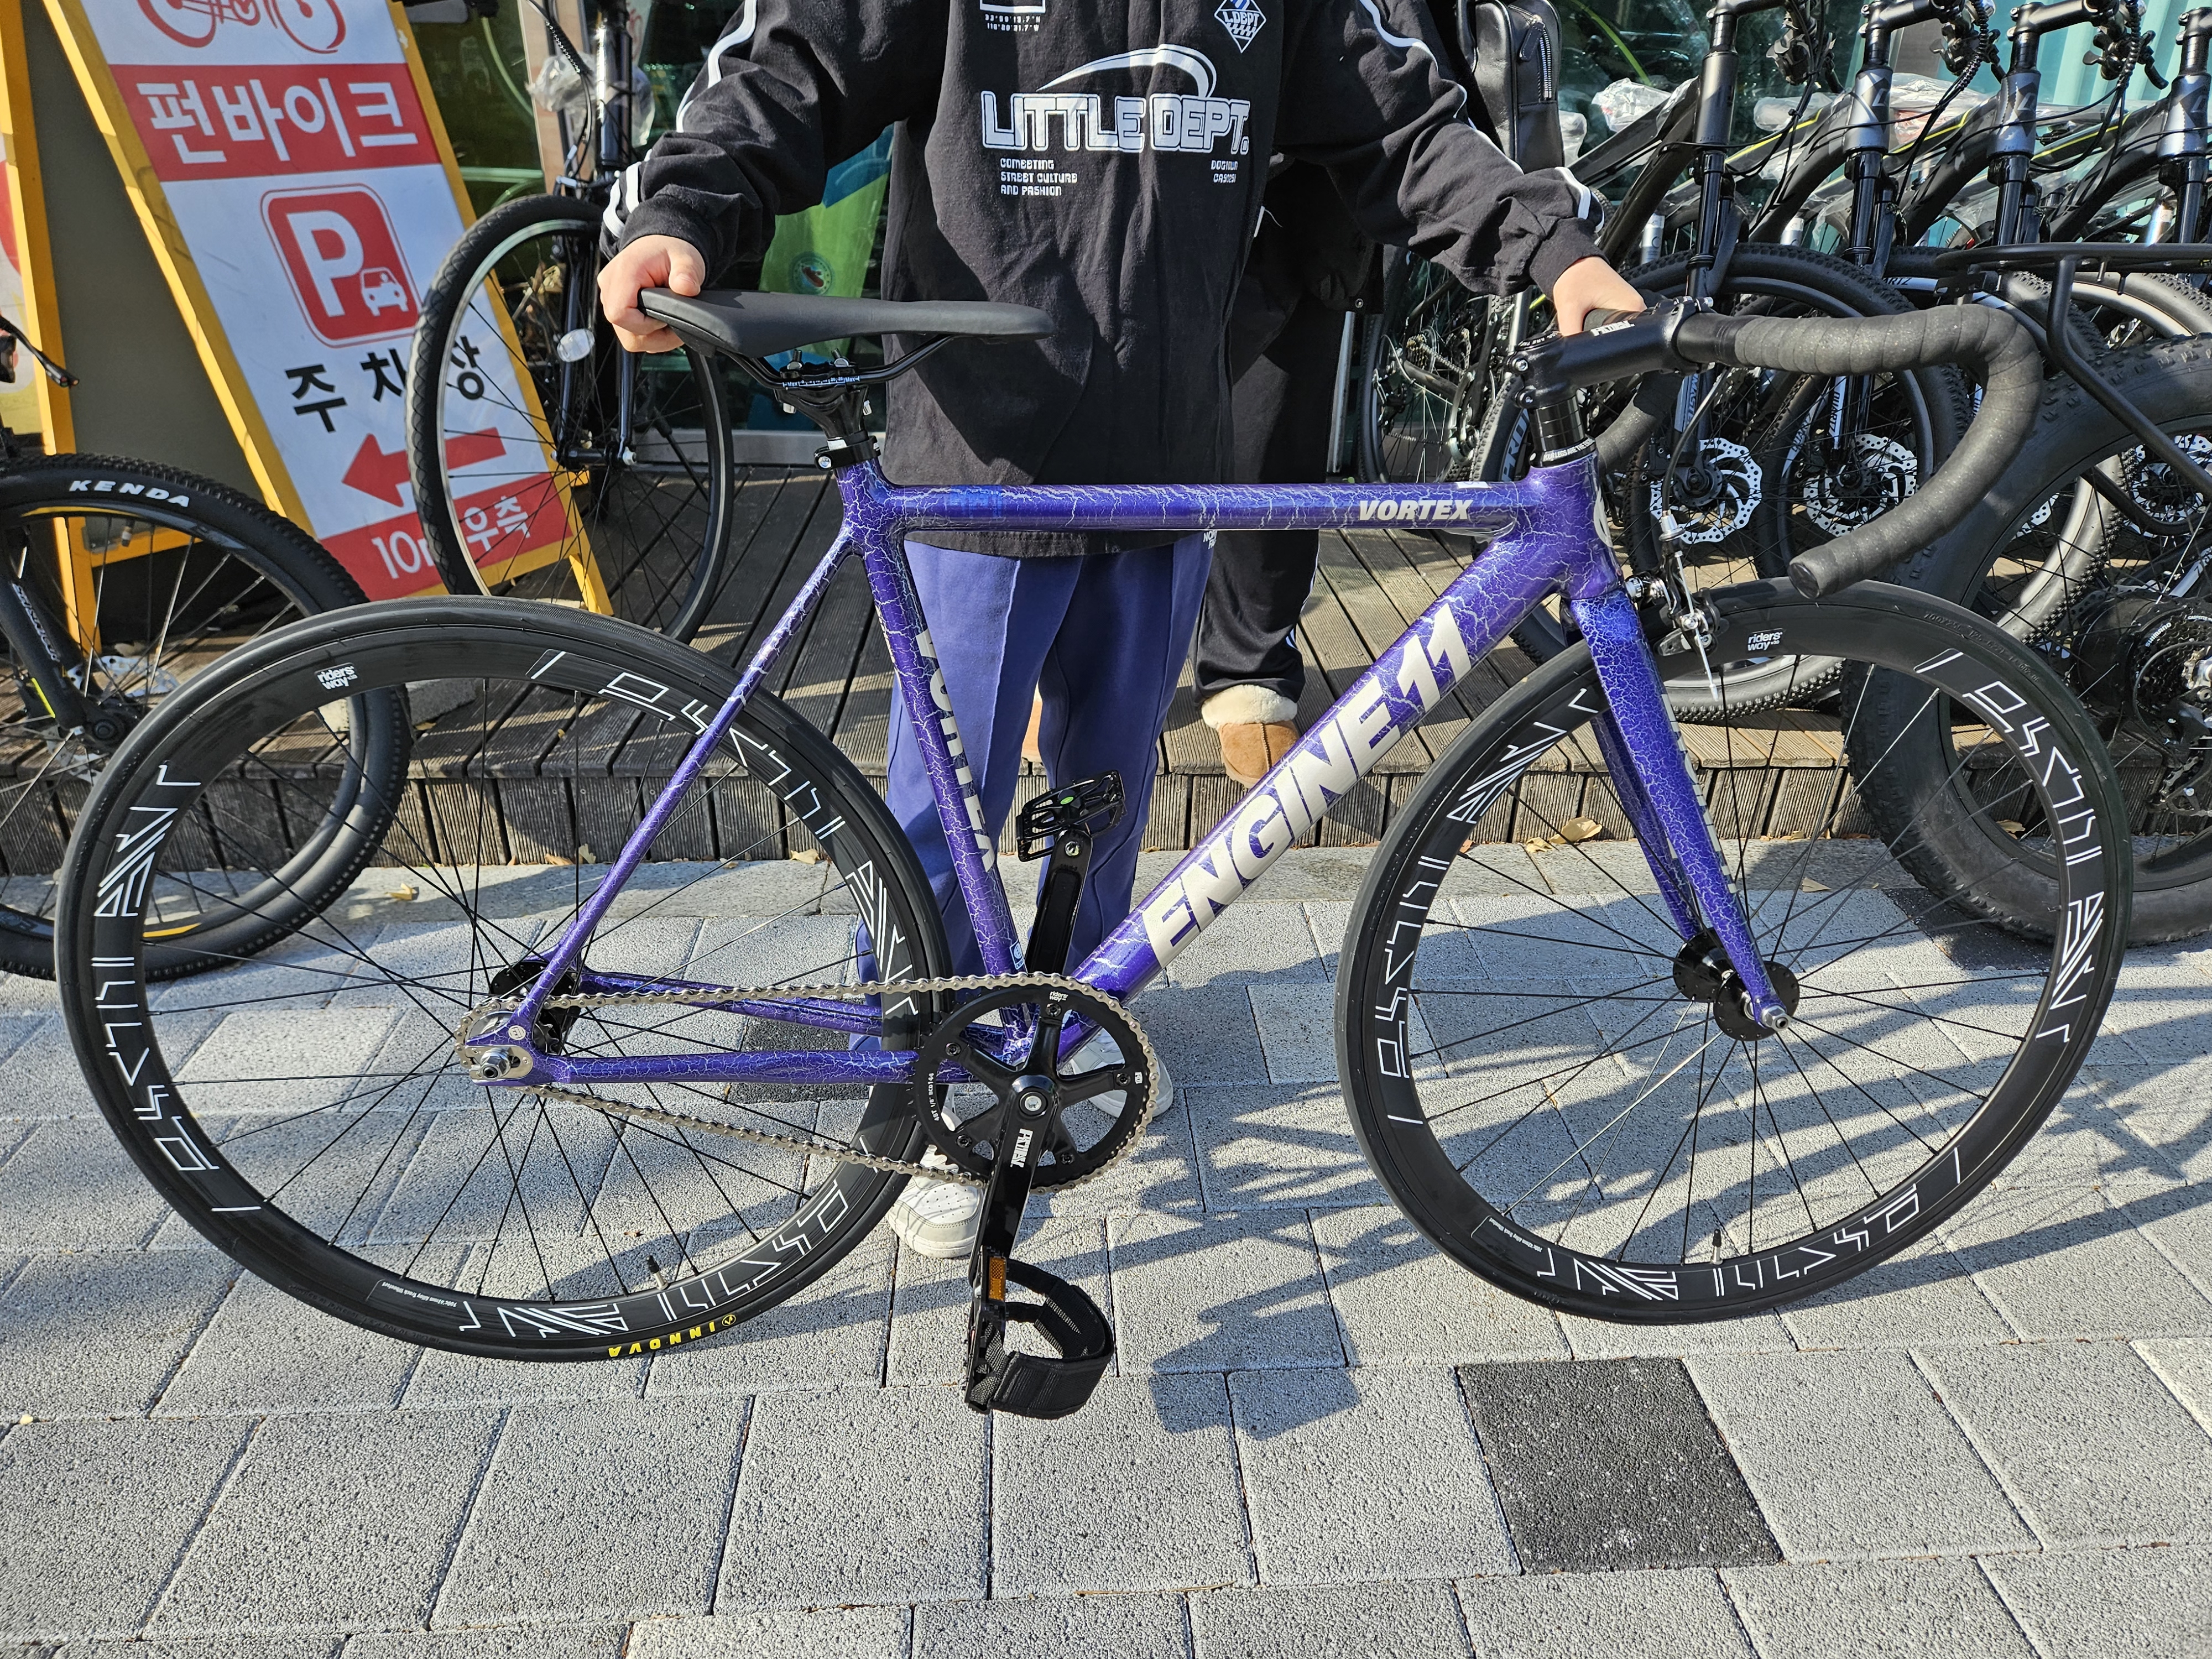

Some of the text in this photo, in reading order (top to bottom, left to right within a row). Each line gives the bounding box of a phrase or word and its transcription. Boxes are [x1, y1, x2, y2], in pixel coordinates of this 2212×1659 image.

[136, 77, 419, 164] 펀바이크
[981, 90, 1250, 155] LITTLE DEPT.
[1001, 171, 1078, 184] STREET CULTURE
[1001, 184, 1019, 195] AND
[286, 209, 364, 317] P
[69, 479, 191, 508] KENDA
[1359, 499, 1474, 521] VORTEX
[464, 495, 531, 552] 우측
[1748, 641, 1770, 651] way
[2145, 622, 2172, 648] SHIMANO
[322, 676, 349, 690] way
[381, 1281, 404, 1294] Wheelset
[404, 1289, 418, 1298] Track
[416, 1292, 431, 1301] Alloy
[608, 1321, 716, 1358] INNOVA
